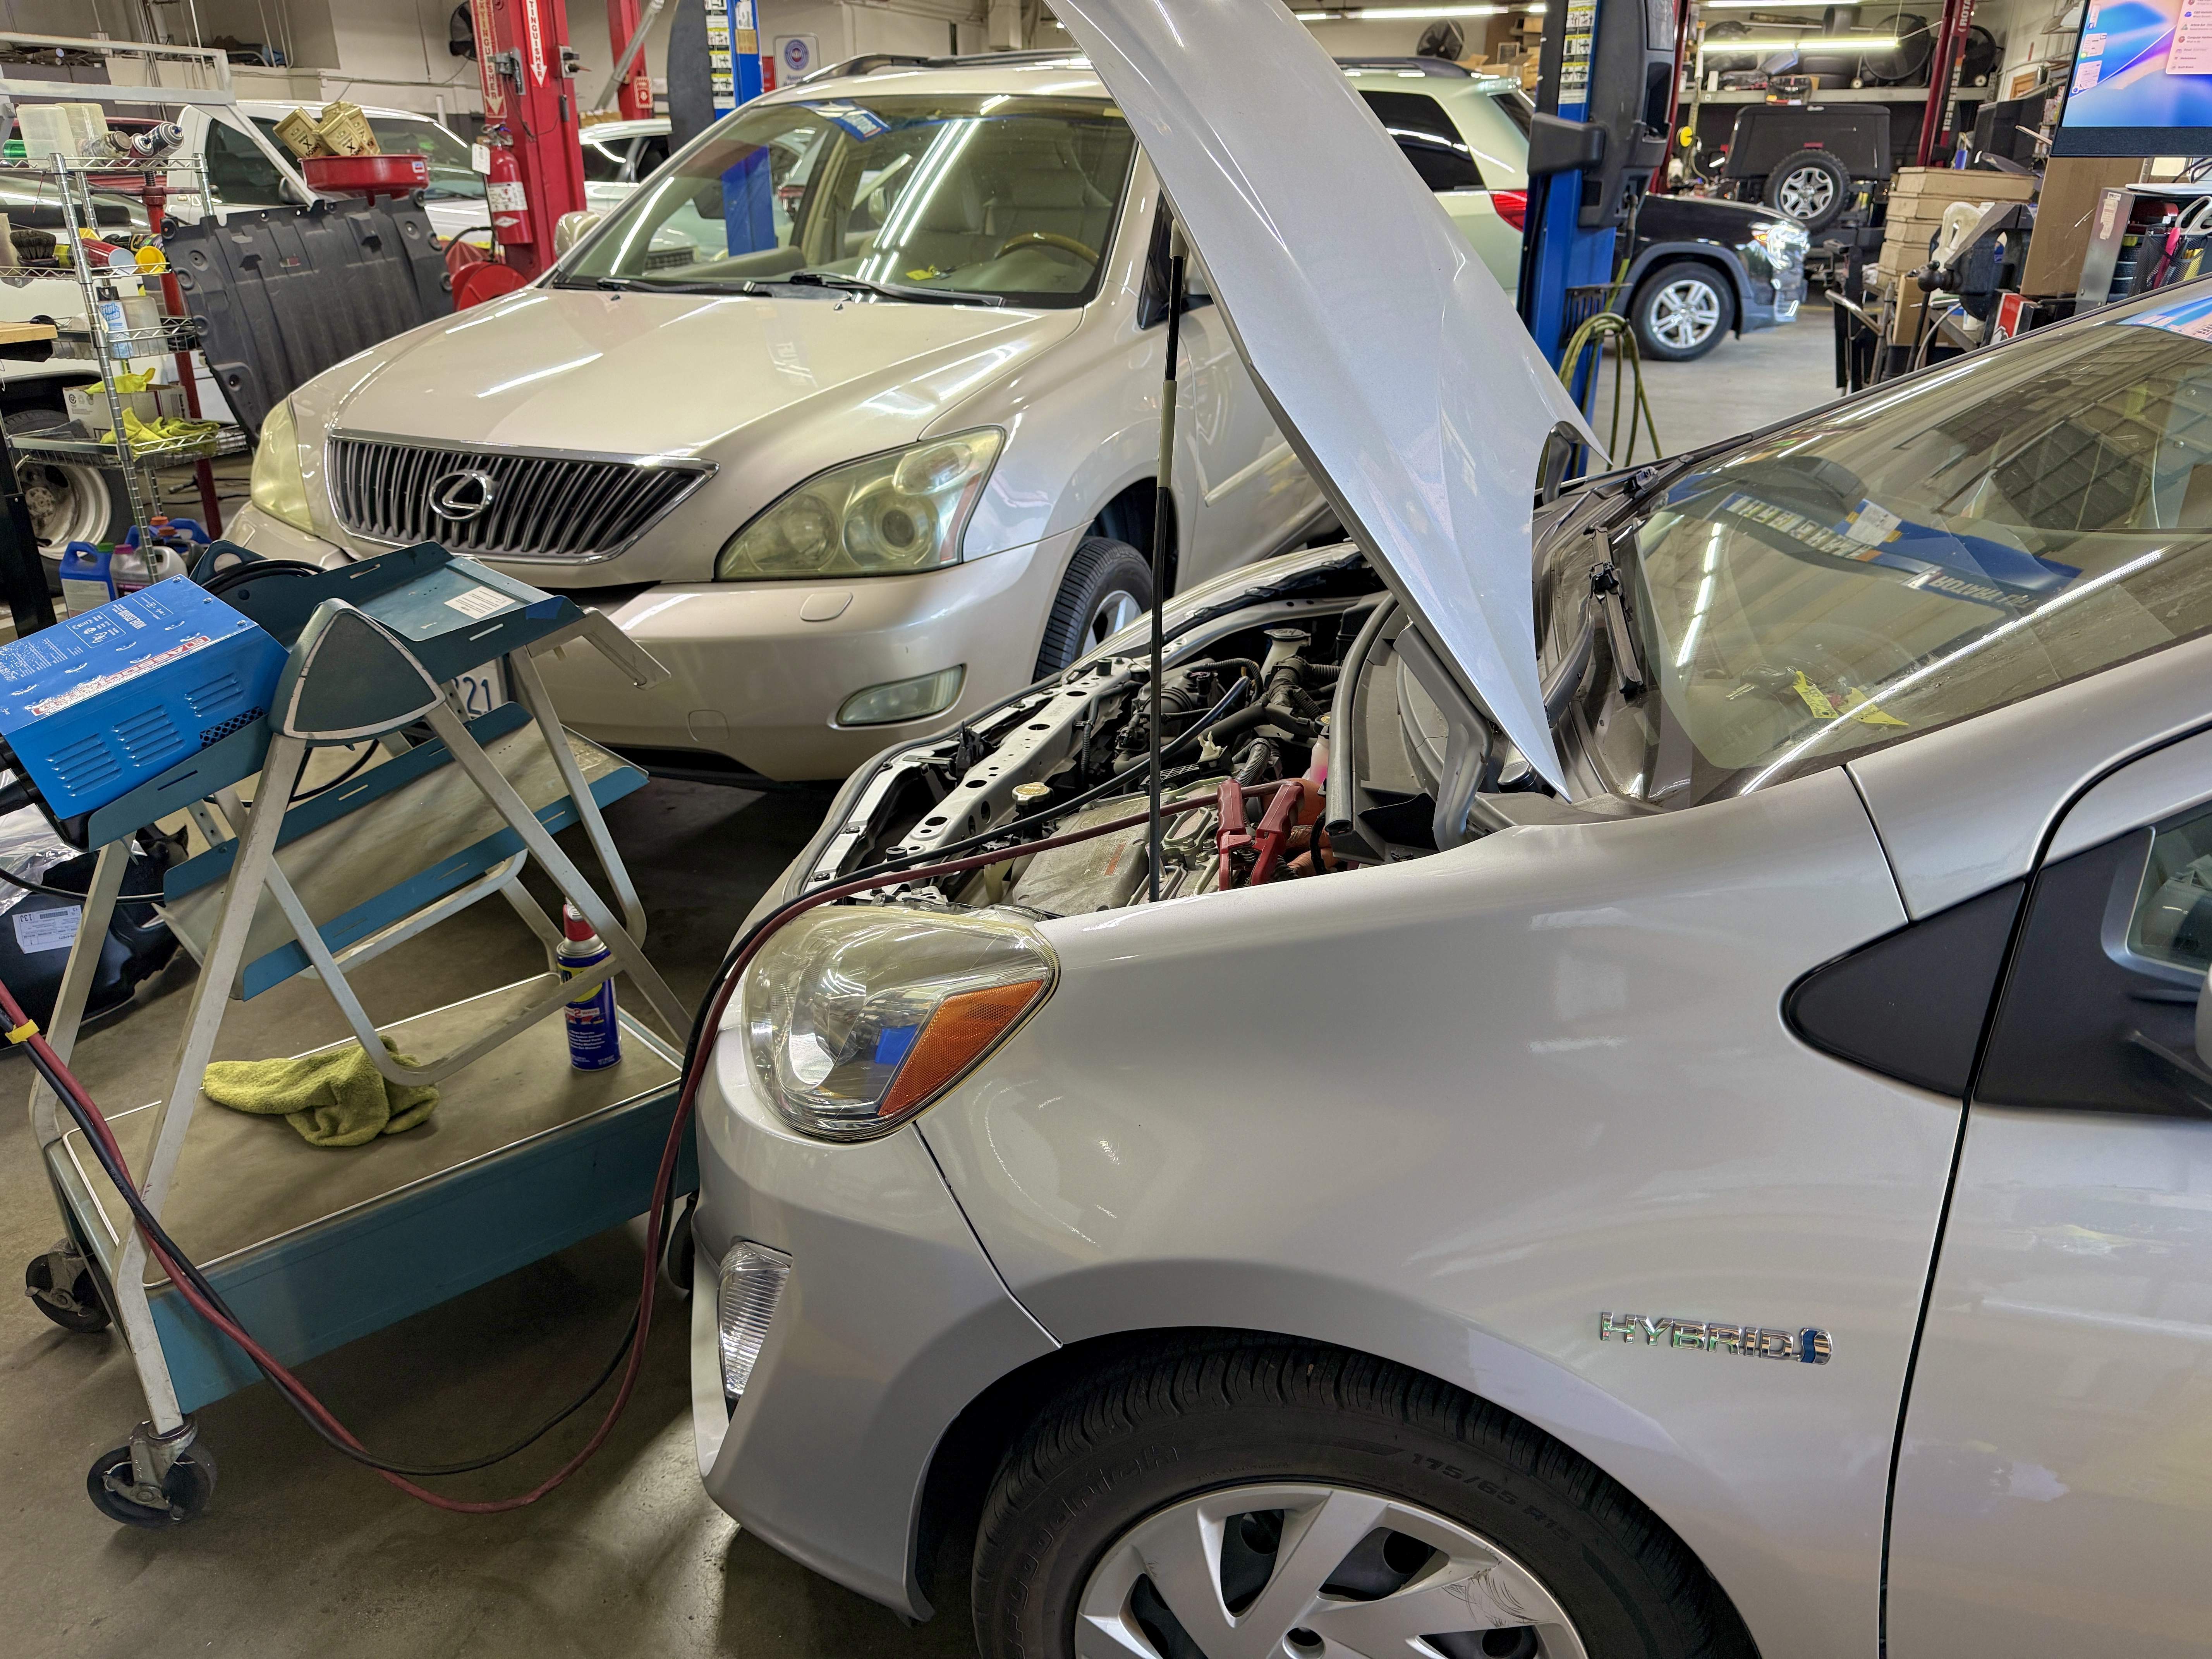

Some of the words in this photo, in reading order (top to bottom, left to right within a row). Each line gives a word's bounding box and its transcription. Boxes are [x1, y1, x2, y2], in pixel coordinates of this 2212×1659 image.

[302, 139, 313, 149] X
[305, 142, 321, 158] ENEOS
[574, 1008, 581, 1017] 2
[1600, 1312, 1793, 1360] HYBRID
[1411, 1452, 1520, 1505] 175/65
